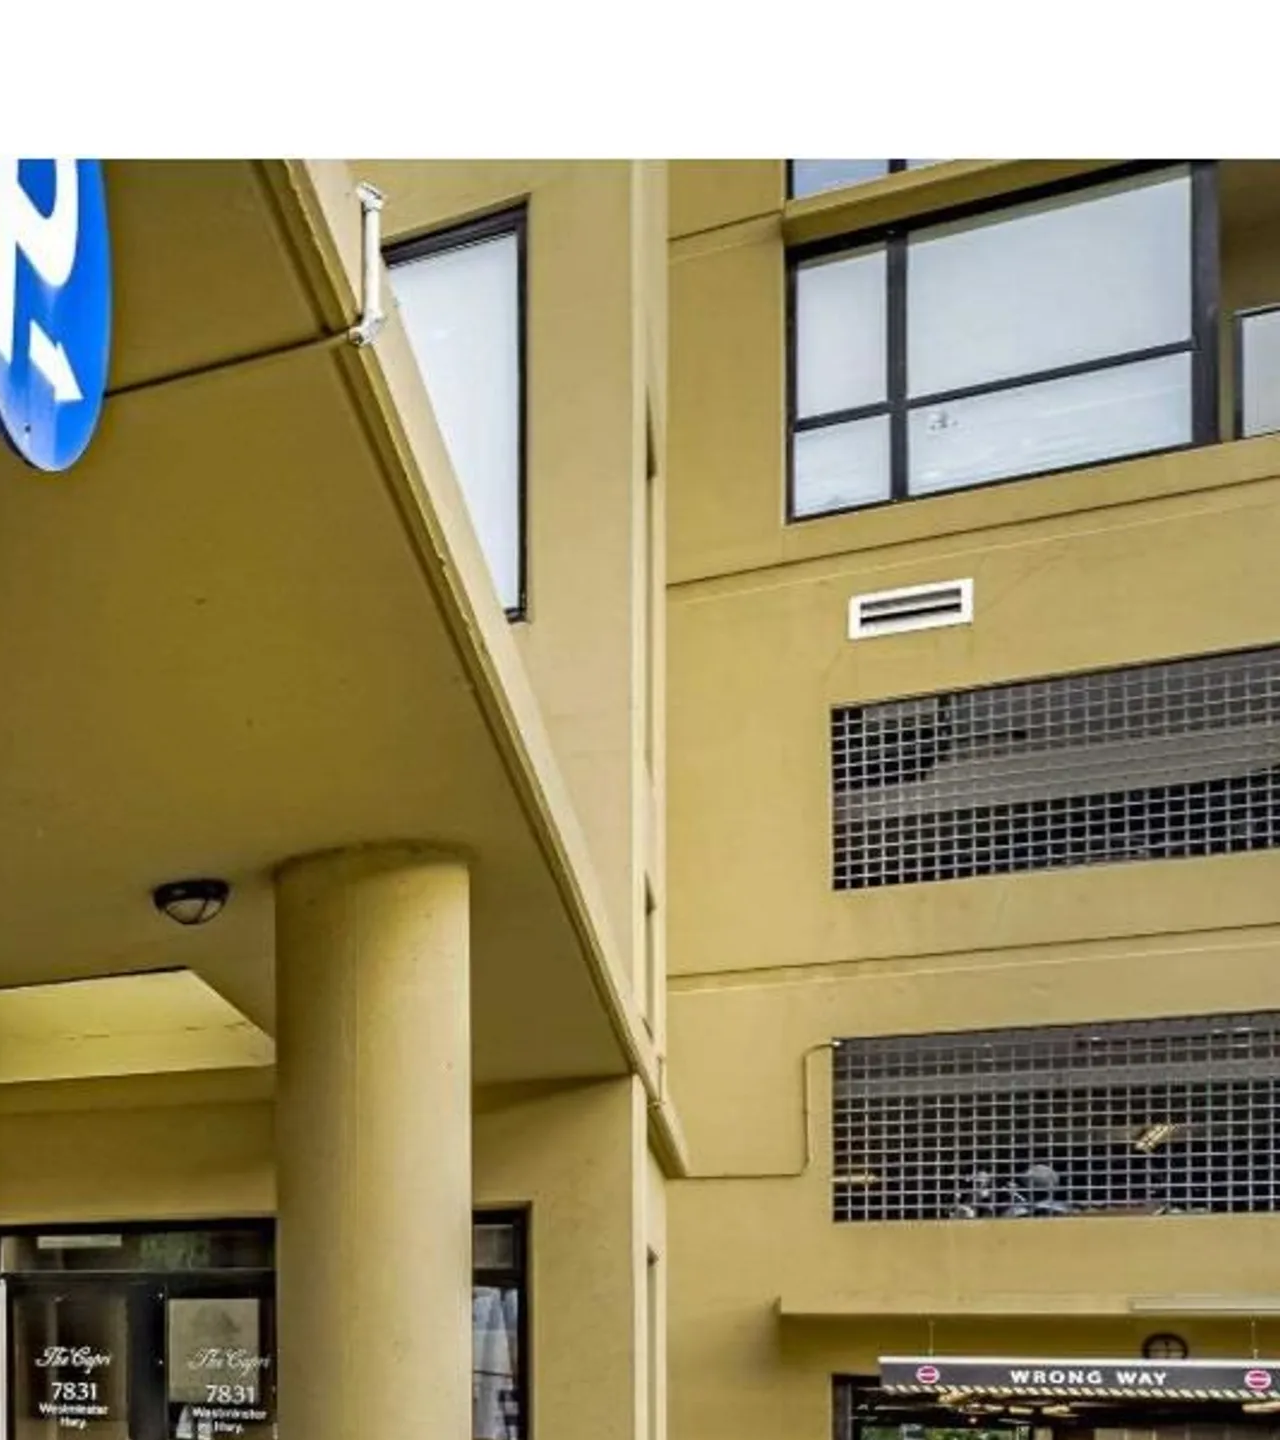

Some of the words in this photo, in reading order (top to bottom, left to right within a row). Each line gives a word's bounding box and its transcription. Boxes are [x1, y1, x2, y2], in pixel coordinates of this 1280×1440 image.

[34, 1346, 70, 1368] The
[1010, 1369, 1104, 1385] WRONG
[1116, 1370, 1168, 1386] WAY
[51, 1382, 97, 1401] 7831
[205, 1384, 256, 1406] 7831
